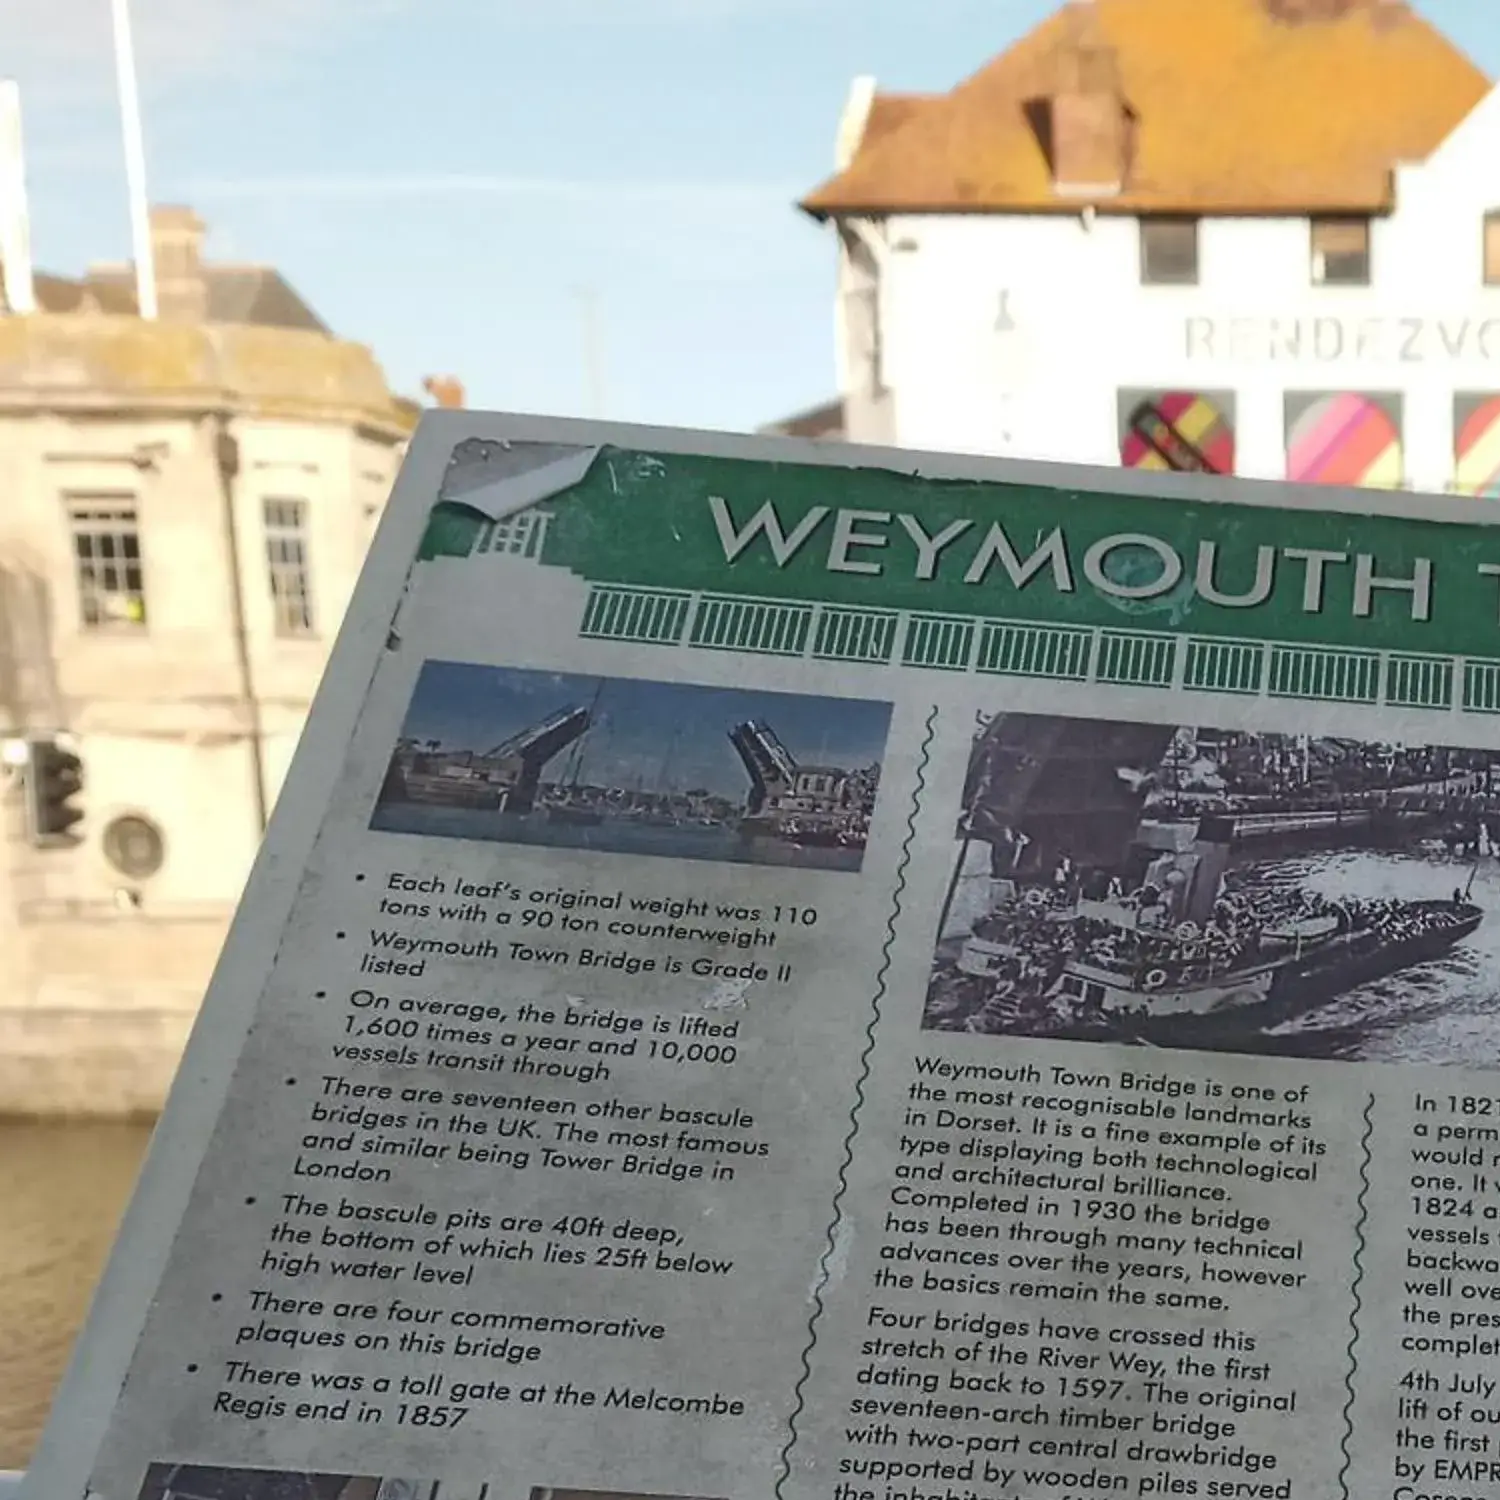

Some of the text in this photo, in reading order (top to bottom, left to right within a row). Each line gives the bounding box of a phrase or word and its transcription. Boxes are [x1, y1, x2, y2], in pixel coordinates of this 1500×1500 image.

[709, 496, 1432, 622] WEYMOUTH
[386, 871, 817, 927] Each leaf's original weight was 110
[369, 928, 791, 984] Weymouth Town Bridge is Grade II
[349, 988, 740, 1039] On average, the bridge is lifted
[914, 1055, 1309, 1103] Weymouth Town Bridge is one of
[1414, 1092, 1437, 1112] In
[310, 1100, 769, 1157] bridges in the UK. The most famous
[898, 1134, 1317, 1183] type displaying both technological
[281, 1193, 684, 1247] The bascule pits are 40ft deep,
[890, 1184, 1270, 1235] Completed in 1930 the bridge
[855, 1361, 1296, 1413] dating back to 1597. The original
[1398, 1367, 1439, 1392] 4th
[1446, 1372, 1496, 1400] July
[844, 1422, 1277, 1473] with two-part central drawbridge
[1394, 1454, 1425, 1483] by
